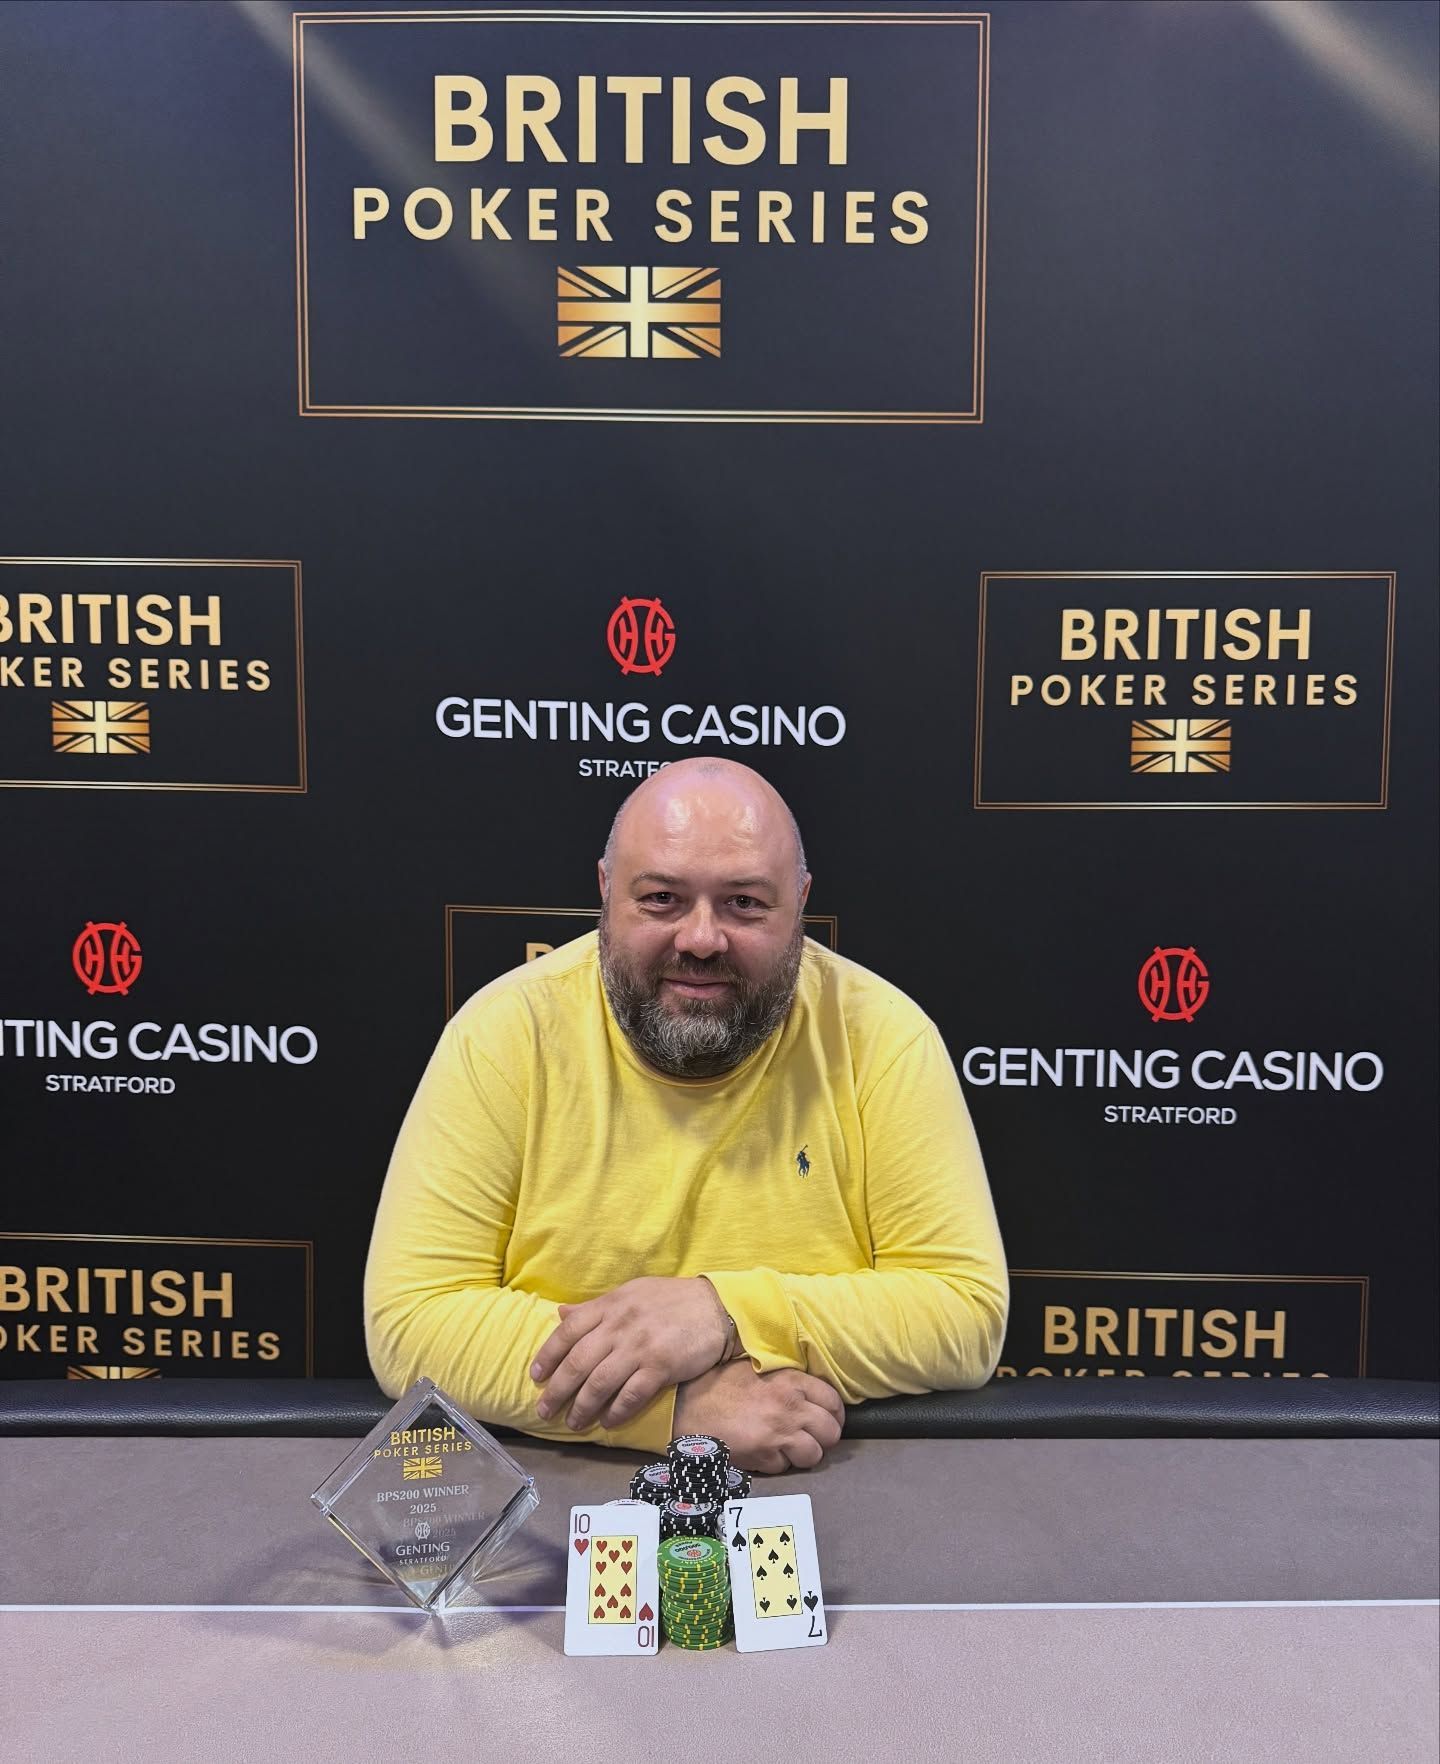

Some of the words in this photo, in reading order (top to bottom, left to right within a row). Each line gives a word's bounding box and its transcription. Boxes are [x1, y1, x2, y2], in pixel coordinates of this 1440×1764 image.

[434, 75, 848, 166] BRITISH
[353, 187, 613, 242] POKER
[654, 189, 930, 245] SERIES
[1060, 608, 1311, 661] BRITISH
[108, 657, 271, 692] SERIES
[1010, 674, 1167, 706] POKER
[1191, 674, 1358, 706] SERIES
[435, 696, 650, 743] GENTING
[661, 703, 847, 747] CASINO
[578, 758, 672, 778] STRATF
[0, 1019, 118, 1060] TING
[128, 1021, 318, 1065] CASINO
[962, 1046, 1180, 1090] GENTING
[1191, 1050, 1384, 1092] CASINO
[45, 1074, 176, 1095] STRATFORD
[1103, 1105, 1237, 1125] STRATFORD
[0, 1265, 233, 1318] BRITISH
[0, 1324, 99, 1354] KER
[123, 1327, 281, 1361] SERIES
[1044, 1305, 1286, 1359] BRITISH
[390, 1426, 456, 1446] BRITISH
[374, 1446, 419, 1458] POKER
[425, 1441, 472, 1454] SERIES
[376, 1489, 420, 1503] BPS200
[423, 1484, 470, 1498] WINNER
[410, 1503, 437, 1515] 2025
[728, 1506, 744, 1529] 7
[574, 1513, 591, 1534] 10
[395, 1541, 450, 1556] GENTING
[399, 1556, 447, 1566] STRATFORD
[637, 1625, 655, 1648] 10
[807, 1615, 823, 1638] 7
